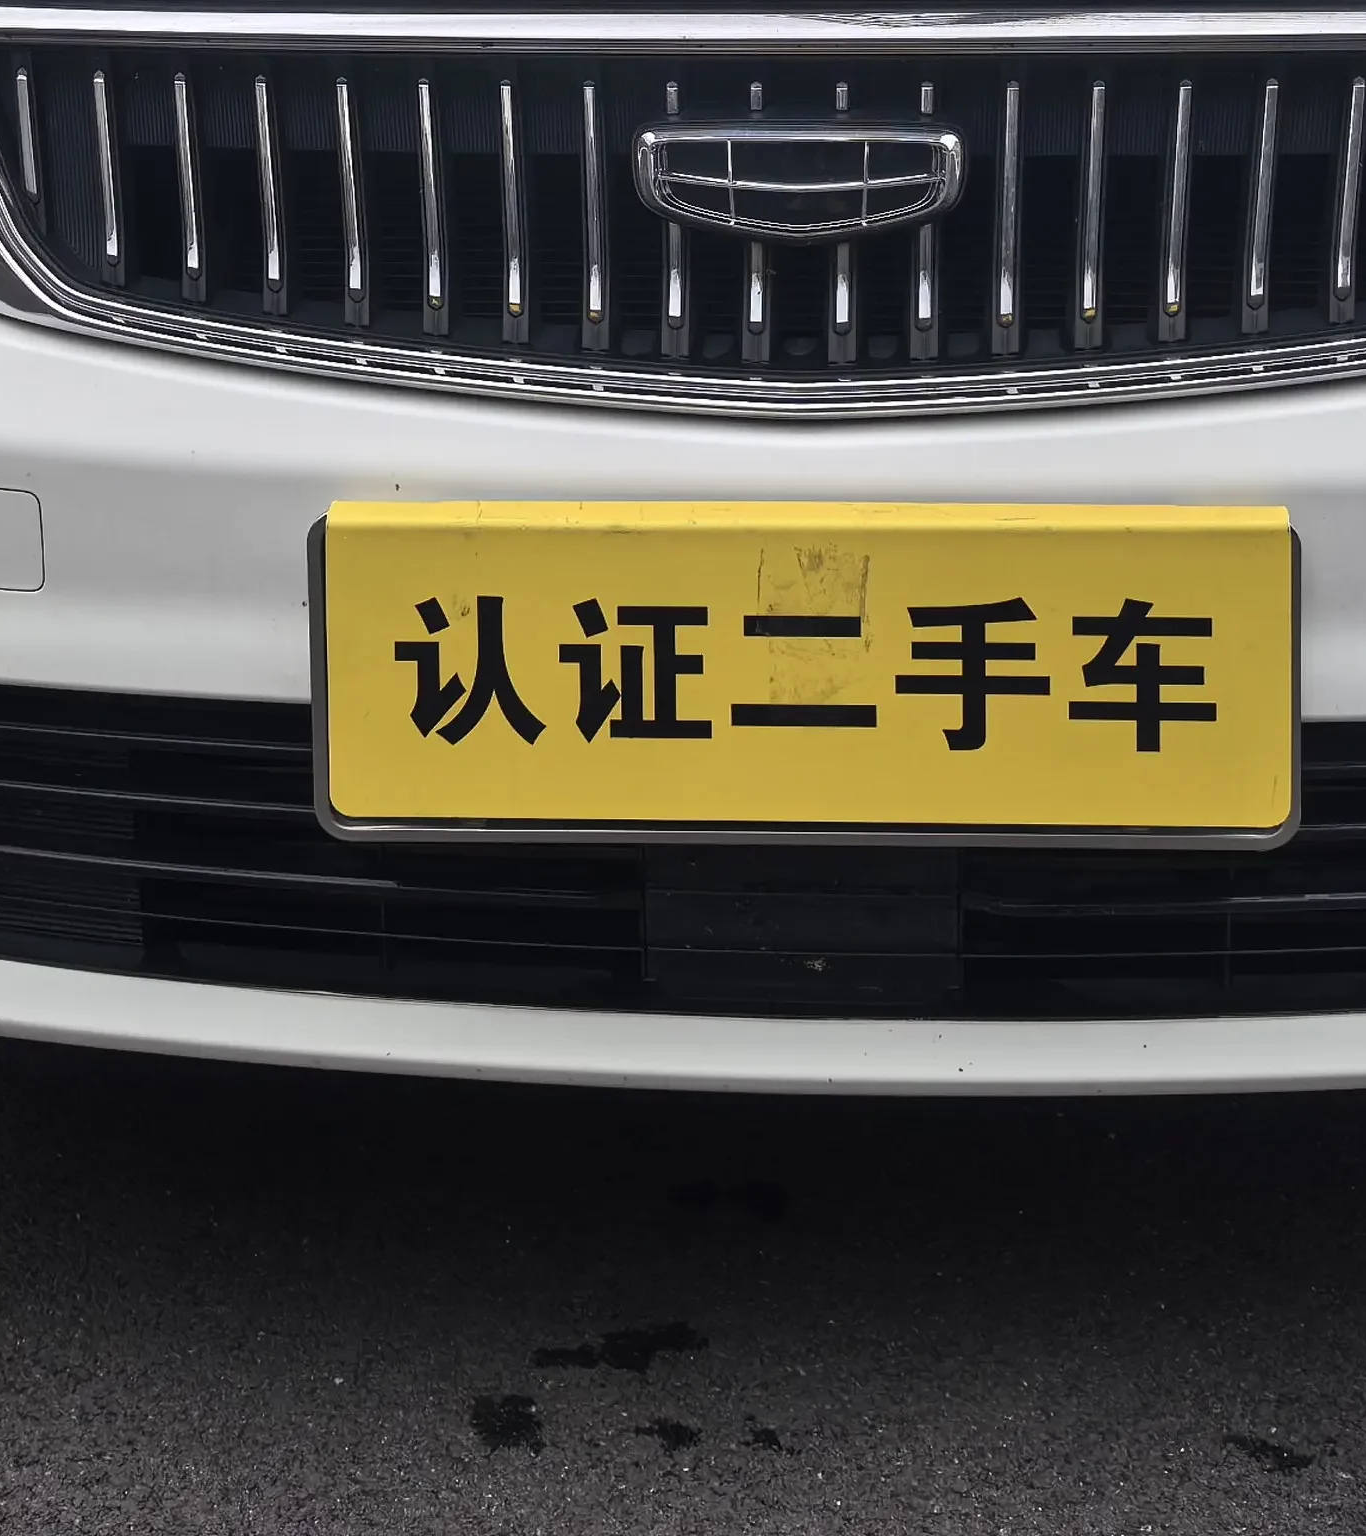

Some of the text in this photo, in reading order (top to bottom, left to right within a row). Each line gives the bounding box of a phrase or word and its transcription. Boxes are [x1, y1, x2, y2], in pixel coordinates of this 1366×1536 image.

[393, 595, 1218, 753] 认证二手车
